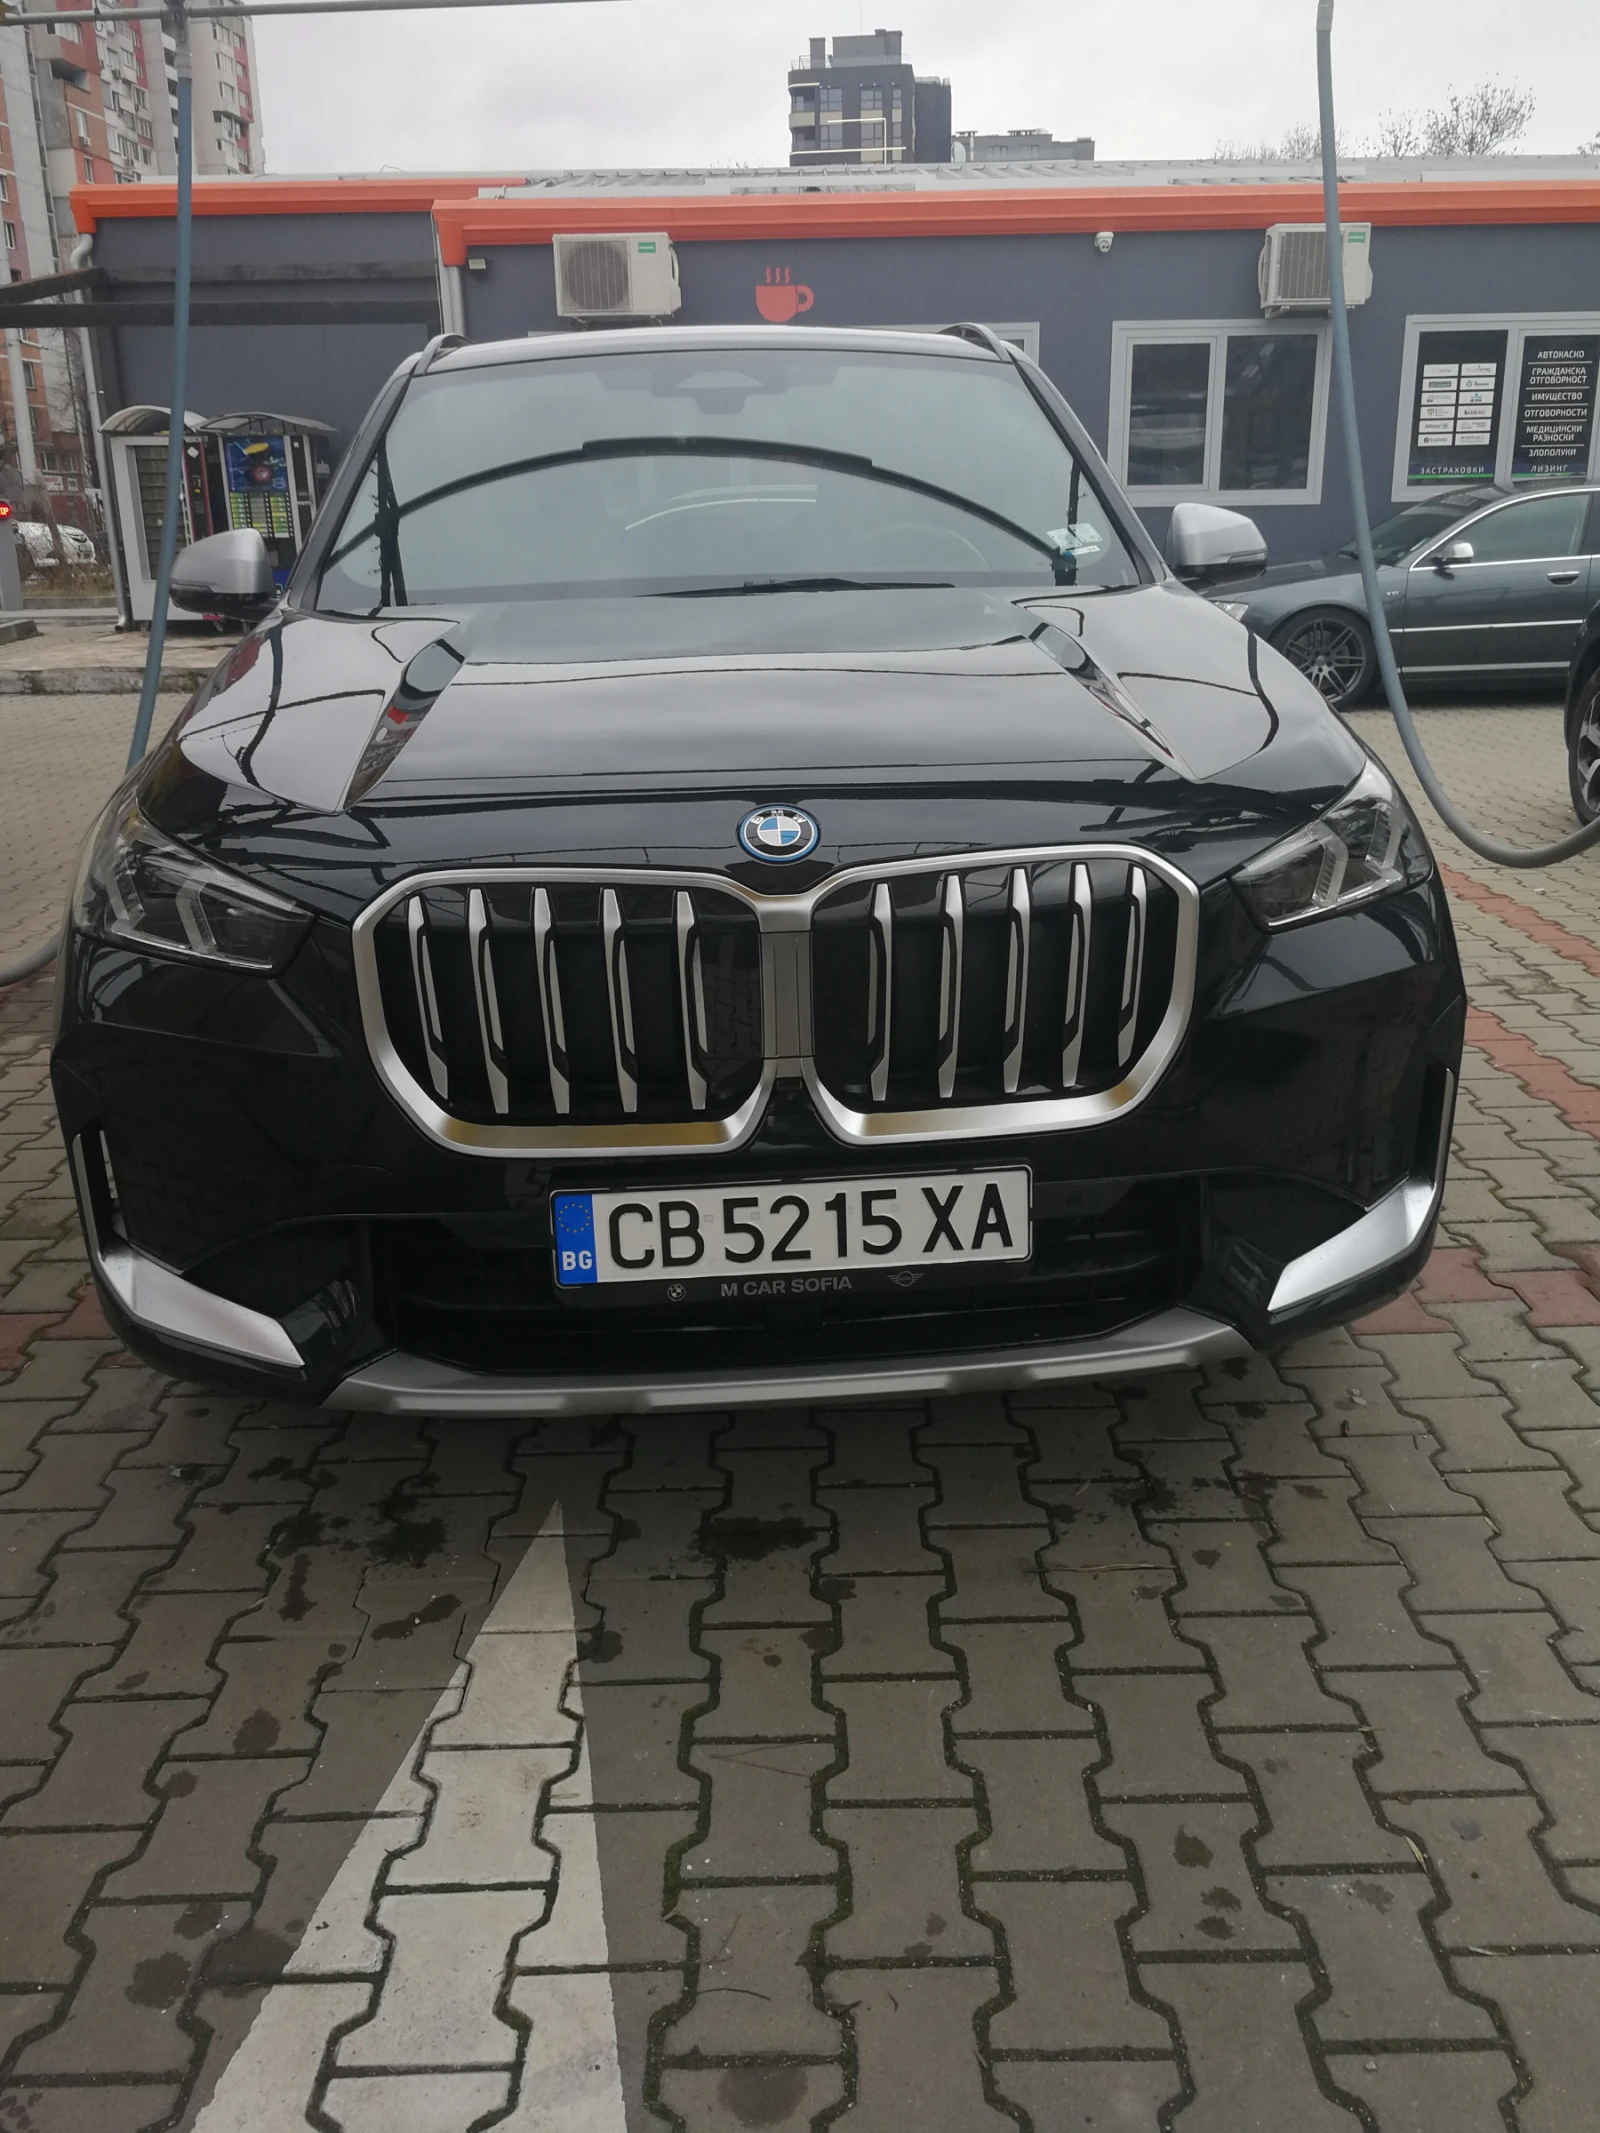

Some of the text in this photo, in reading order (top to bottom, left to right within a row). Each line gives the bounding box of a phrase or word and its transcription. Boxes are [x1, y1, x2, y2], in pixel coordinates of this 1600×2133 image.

[1537, 350, 1585, 359] АВТОКАСКО
[1532, 367, 1586, 376] ГРАЖДАНСКА
[1529, 375, 1588, 384] ОТГОВОРНОСТ
[1531, 392, 1583, 401] ИМУЩЕСТВО
[1524, 408, 1588, 417] ОТГОВОРНОСТИ
[1526, 425, 1583, 434] МЕДИЦИНСКИ
[1532, 433, 1575, 442] РАЗНОСКИ
[1528, 448, 1577, 457] ЗЛОПОЛУКИ
[1420, 466, 1485, 475] ЗАСТРАХОВКИ
[1530, 464, 1568, 473] ЛИЗИНГ
[608, 1182, 1014, 1269] CB 5215 XA
[562, 1250, 593, 1271] BG
[720, 1275, 853, 1297] M CAR SOFIA
